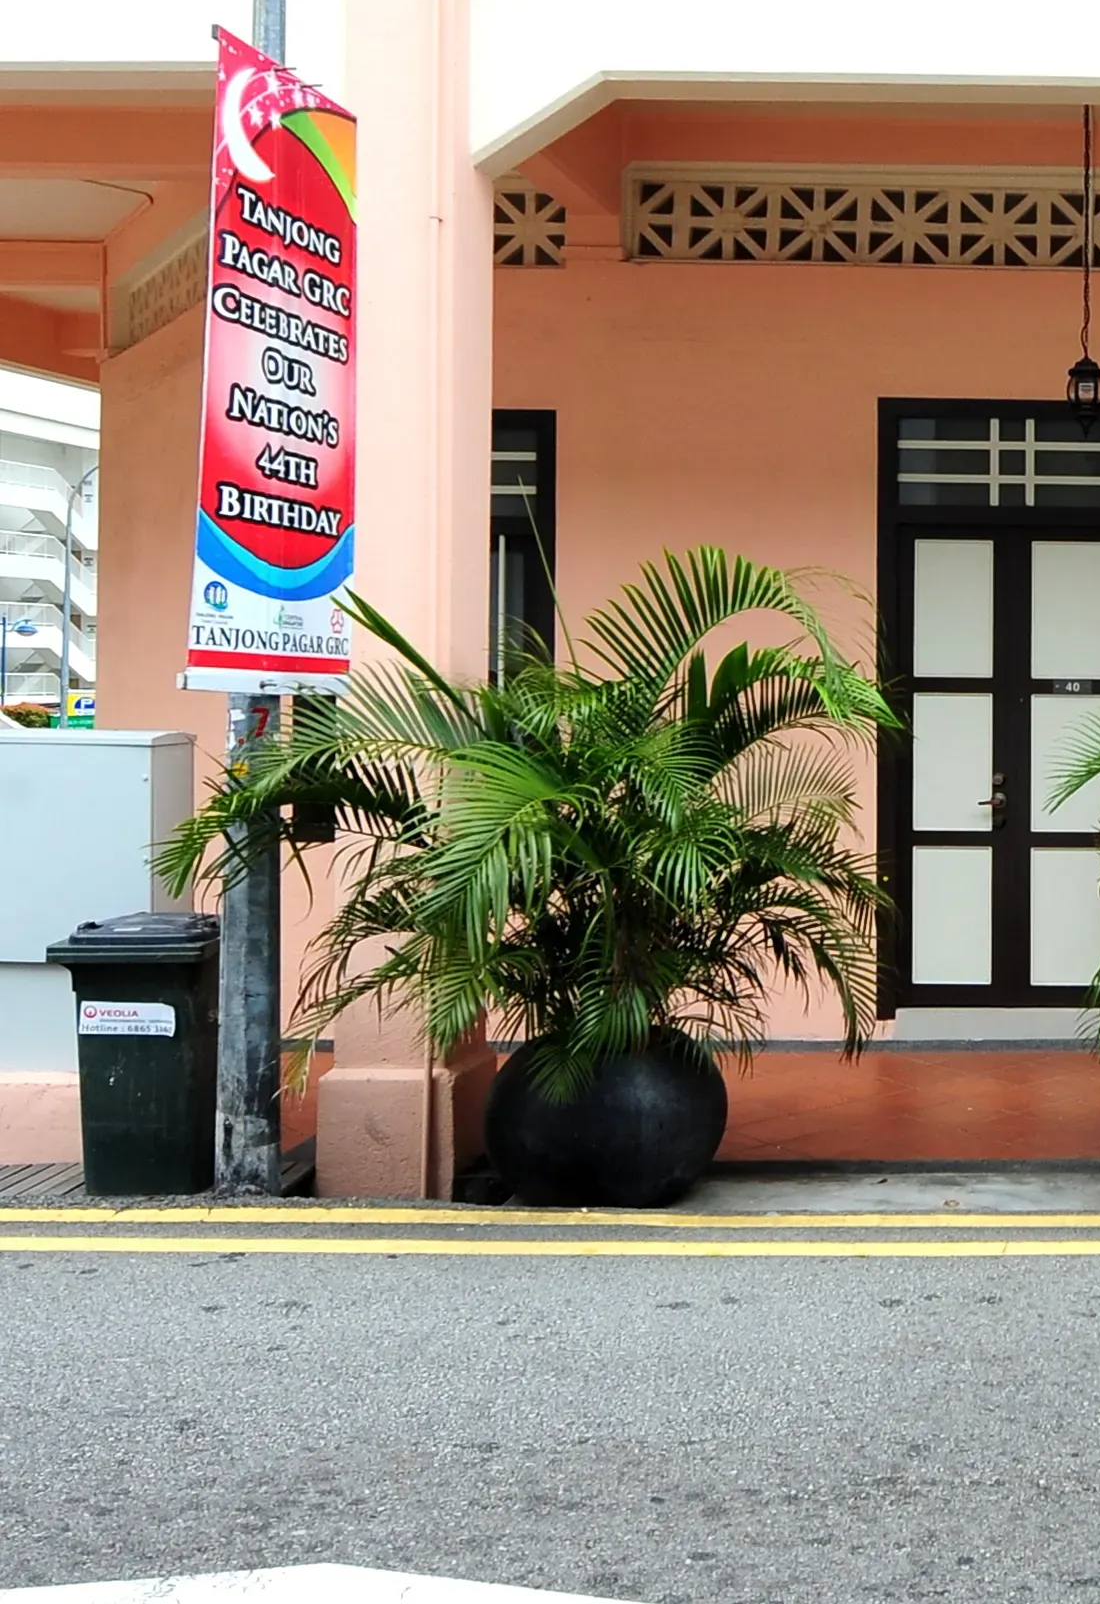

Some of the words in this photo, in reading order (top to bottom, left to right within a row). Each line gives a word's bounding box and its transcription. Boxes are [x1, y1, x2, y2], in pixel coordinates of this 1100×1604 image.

[237, 187, 341, 264] TANJONG
[221, 232, 300, 294] PAGAR
[303, 267, 351, 317] GRC
[213, 287, 349, 364] CELEBRATES
[263, 351, 315, 393] OUR
[229, 386, 339, 446] NATION'S
[258, 446, 316, 486] 44TH
[219, 484, 341, 536] BIRTHDAY
[192, 625, 280, 651] TANJONG
[282, 632, 324, 654] PAGAR
[325, 636, 349, 656] GRC
[80, 698, 94, 709] P
[1065, 682, 1080, 692] 40
[251, 707, 270, 737] 7
[81, 1024, 118, 1032] Hotline
[99, 1009, 139, 1017] VEOLIA
